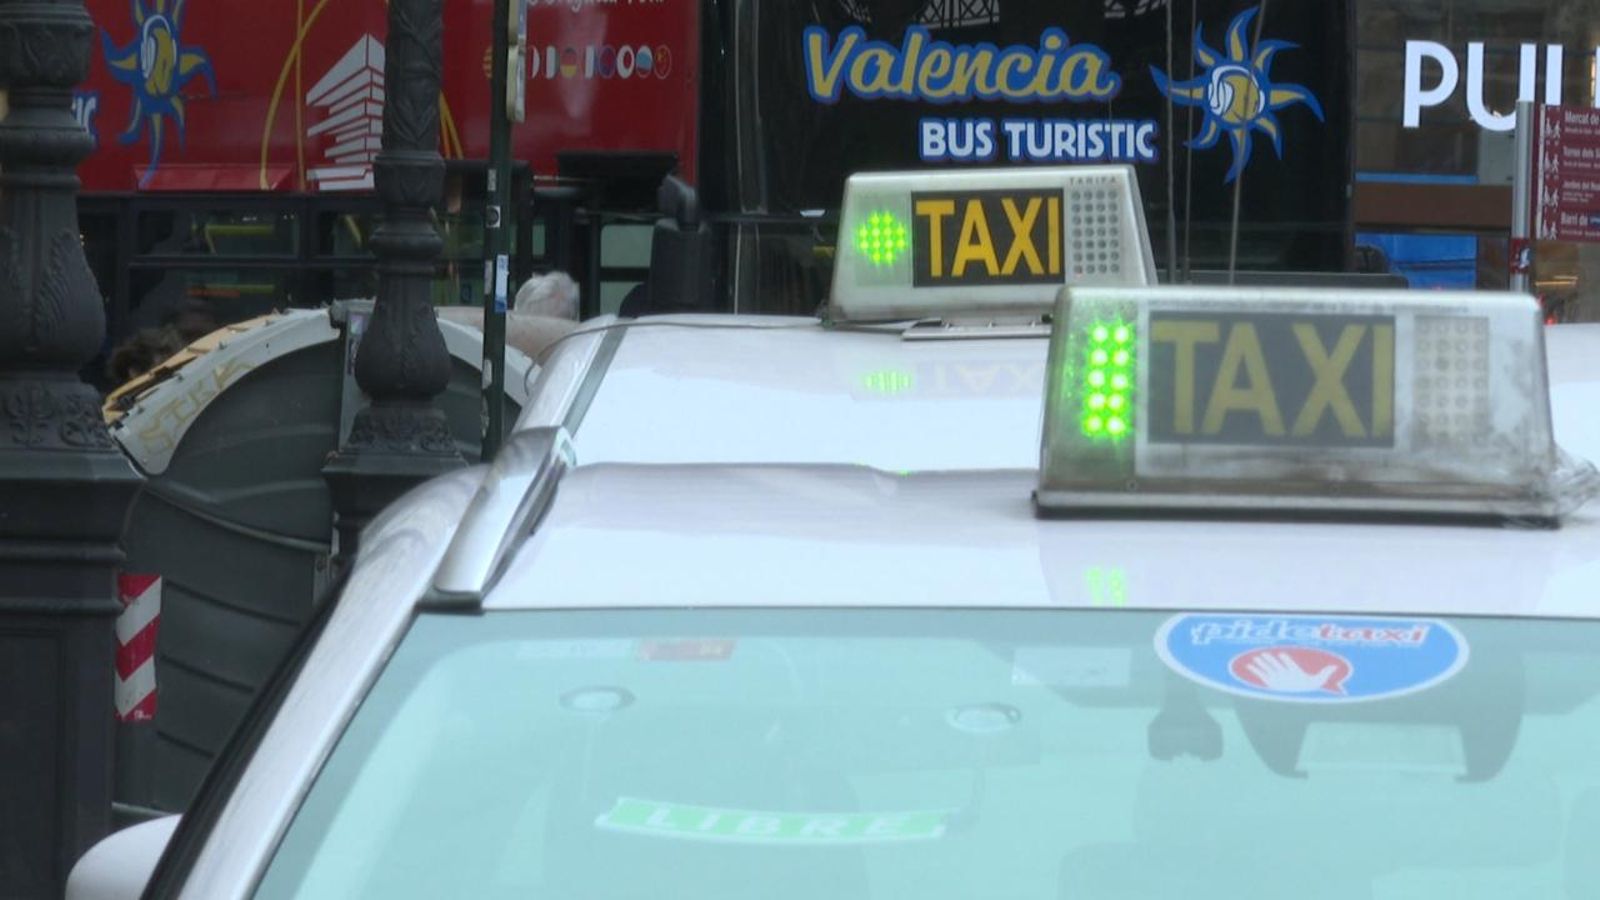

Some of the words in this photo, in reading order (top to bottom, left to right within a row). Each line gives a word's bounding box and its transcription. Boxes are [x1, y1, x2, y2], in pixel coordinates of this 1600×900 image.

[806, 30, 1117, 98] Valencia
[921, 122, 992, 157] BUS
[1004, 121, 1154, 158] TURISTIC
[916, 196, 1061, 277] TAXI
[1151, 320, 1393, 438] TAXI
[644, 806, 912, 838] LIBRE
